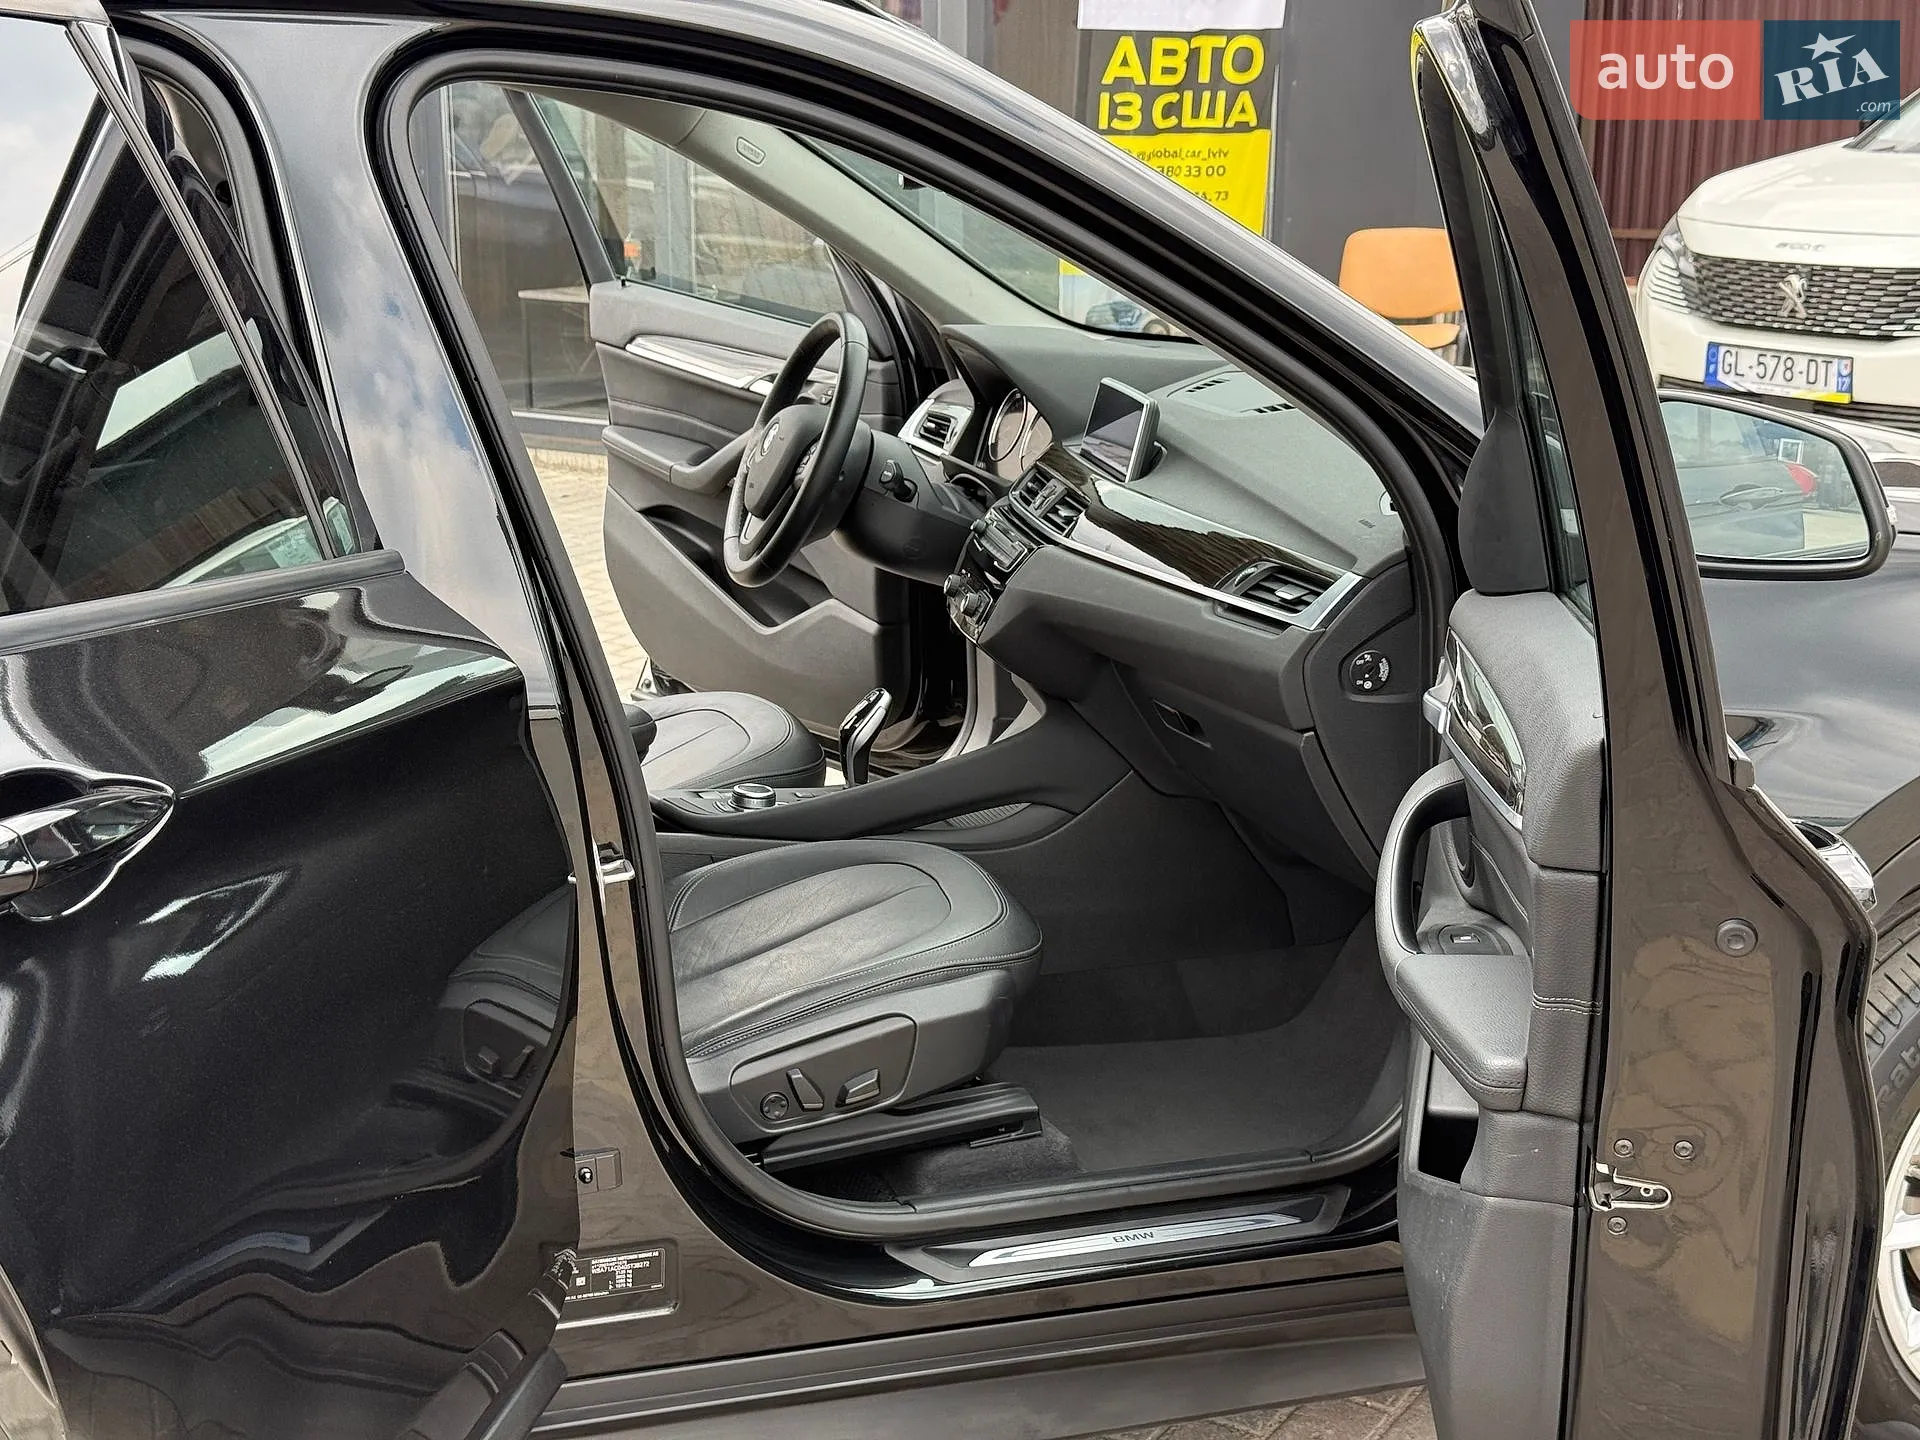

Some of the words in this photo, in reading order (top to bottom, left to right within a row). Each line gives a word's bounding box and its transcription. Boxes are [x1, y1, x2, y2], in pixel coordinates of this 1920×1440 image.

[1101, 34, 1265, 86] АВТО
[1151, 90, 1258, 129] США
[1184, 165, 1201, 177] 33
[1205, 165, 1226, 177] 00
[1722, 349, 1833, 387] GL-578-DT
[1112, 1231, 1155, 1243] BMW
